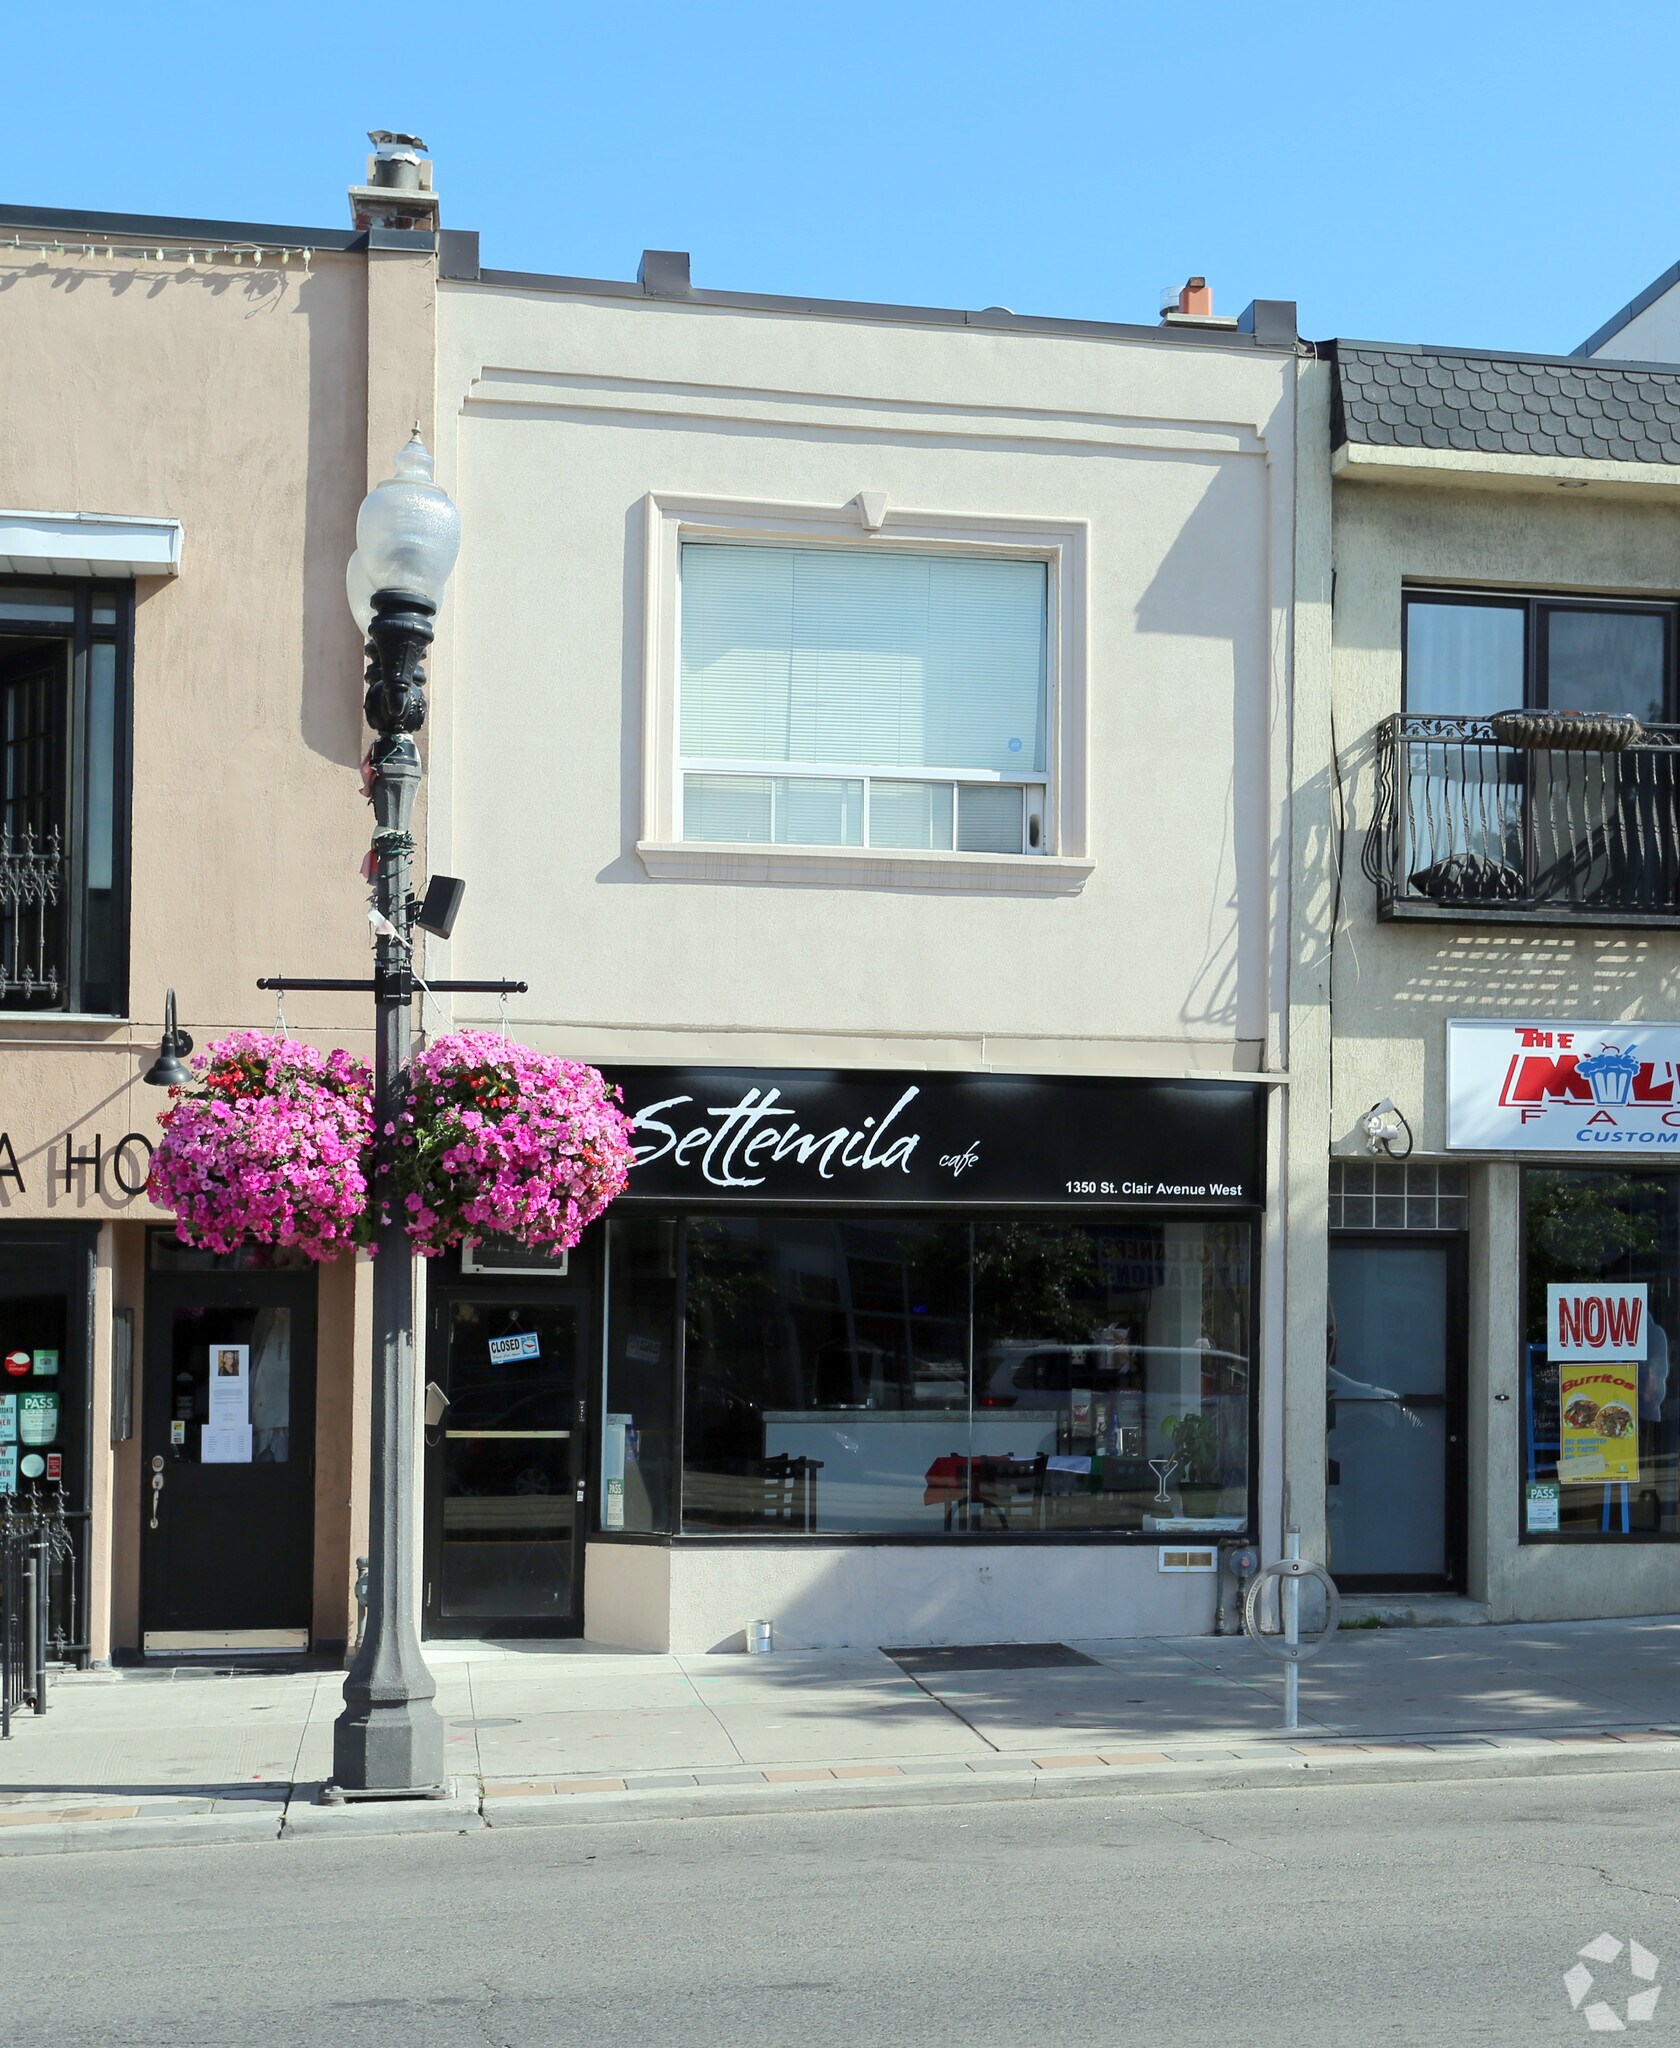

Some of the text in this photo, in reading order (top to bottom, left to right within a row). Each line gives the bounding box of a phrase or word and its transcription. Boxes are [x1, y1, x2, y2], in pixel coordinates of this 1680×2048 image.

[1514, 1028, 1575, 1049] THE
[1576, 1129, 1678, 1143] CUSTOM
[1065, 1181, 1243, 1196] 1350 St. Clair Avenue West
[1558, 1296, 1643, 1348] NOW
[490, 1338, 520, 1354] CLOSED
[1561, 1373, 1636, 1394] Burritos
[24, 1398, 54, 1409] PASS
[608, 1484, 622, 1494] PASS
[1530, 1488, 1555, 1499] PASS
